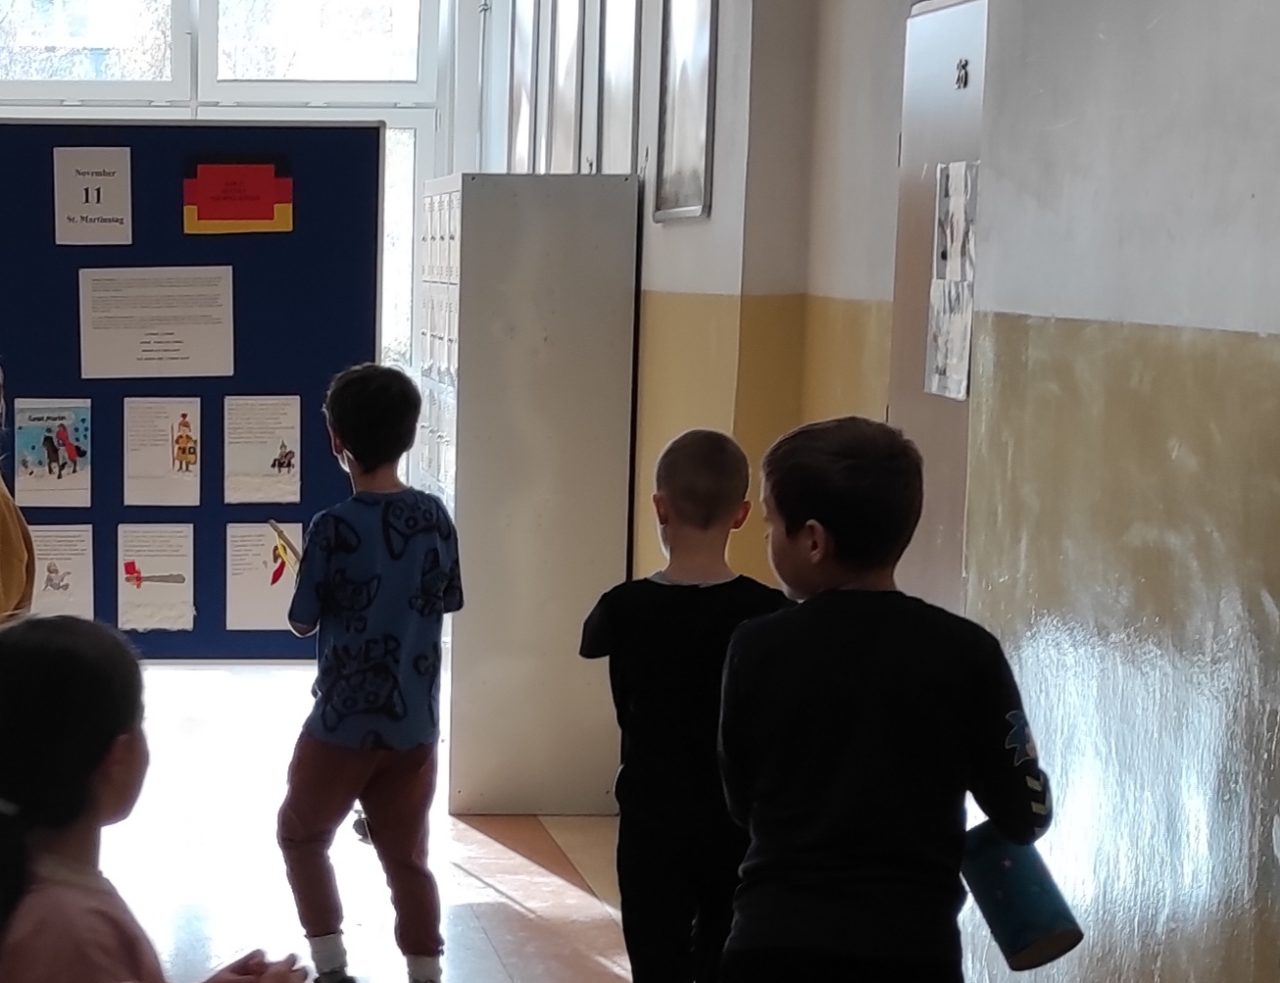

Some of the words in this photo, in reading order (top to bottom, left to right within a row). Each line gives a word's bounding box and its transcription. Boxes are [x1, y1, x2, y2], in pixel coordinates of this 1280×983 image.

[75, 169, 116, 177] November
[83, 186, 101, 204] 11
[66, 215, 78, 224] St.
